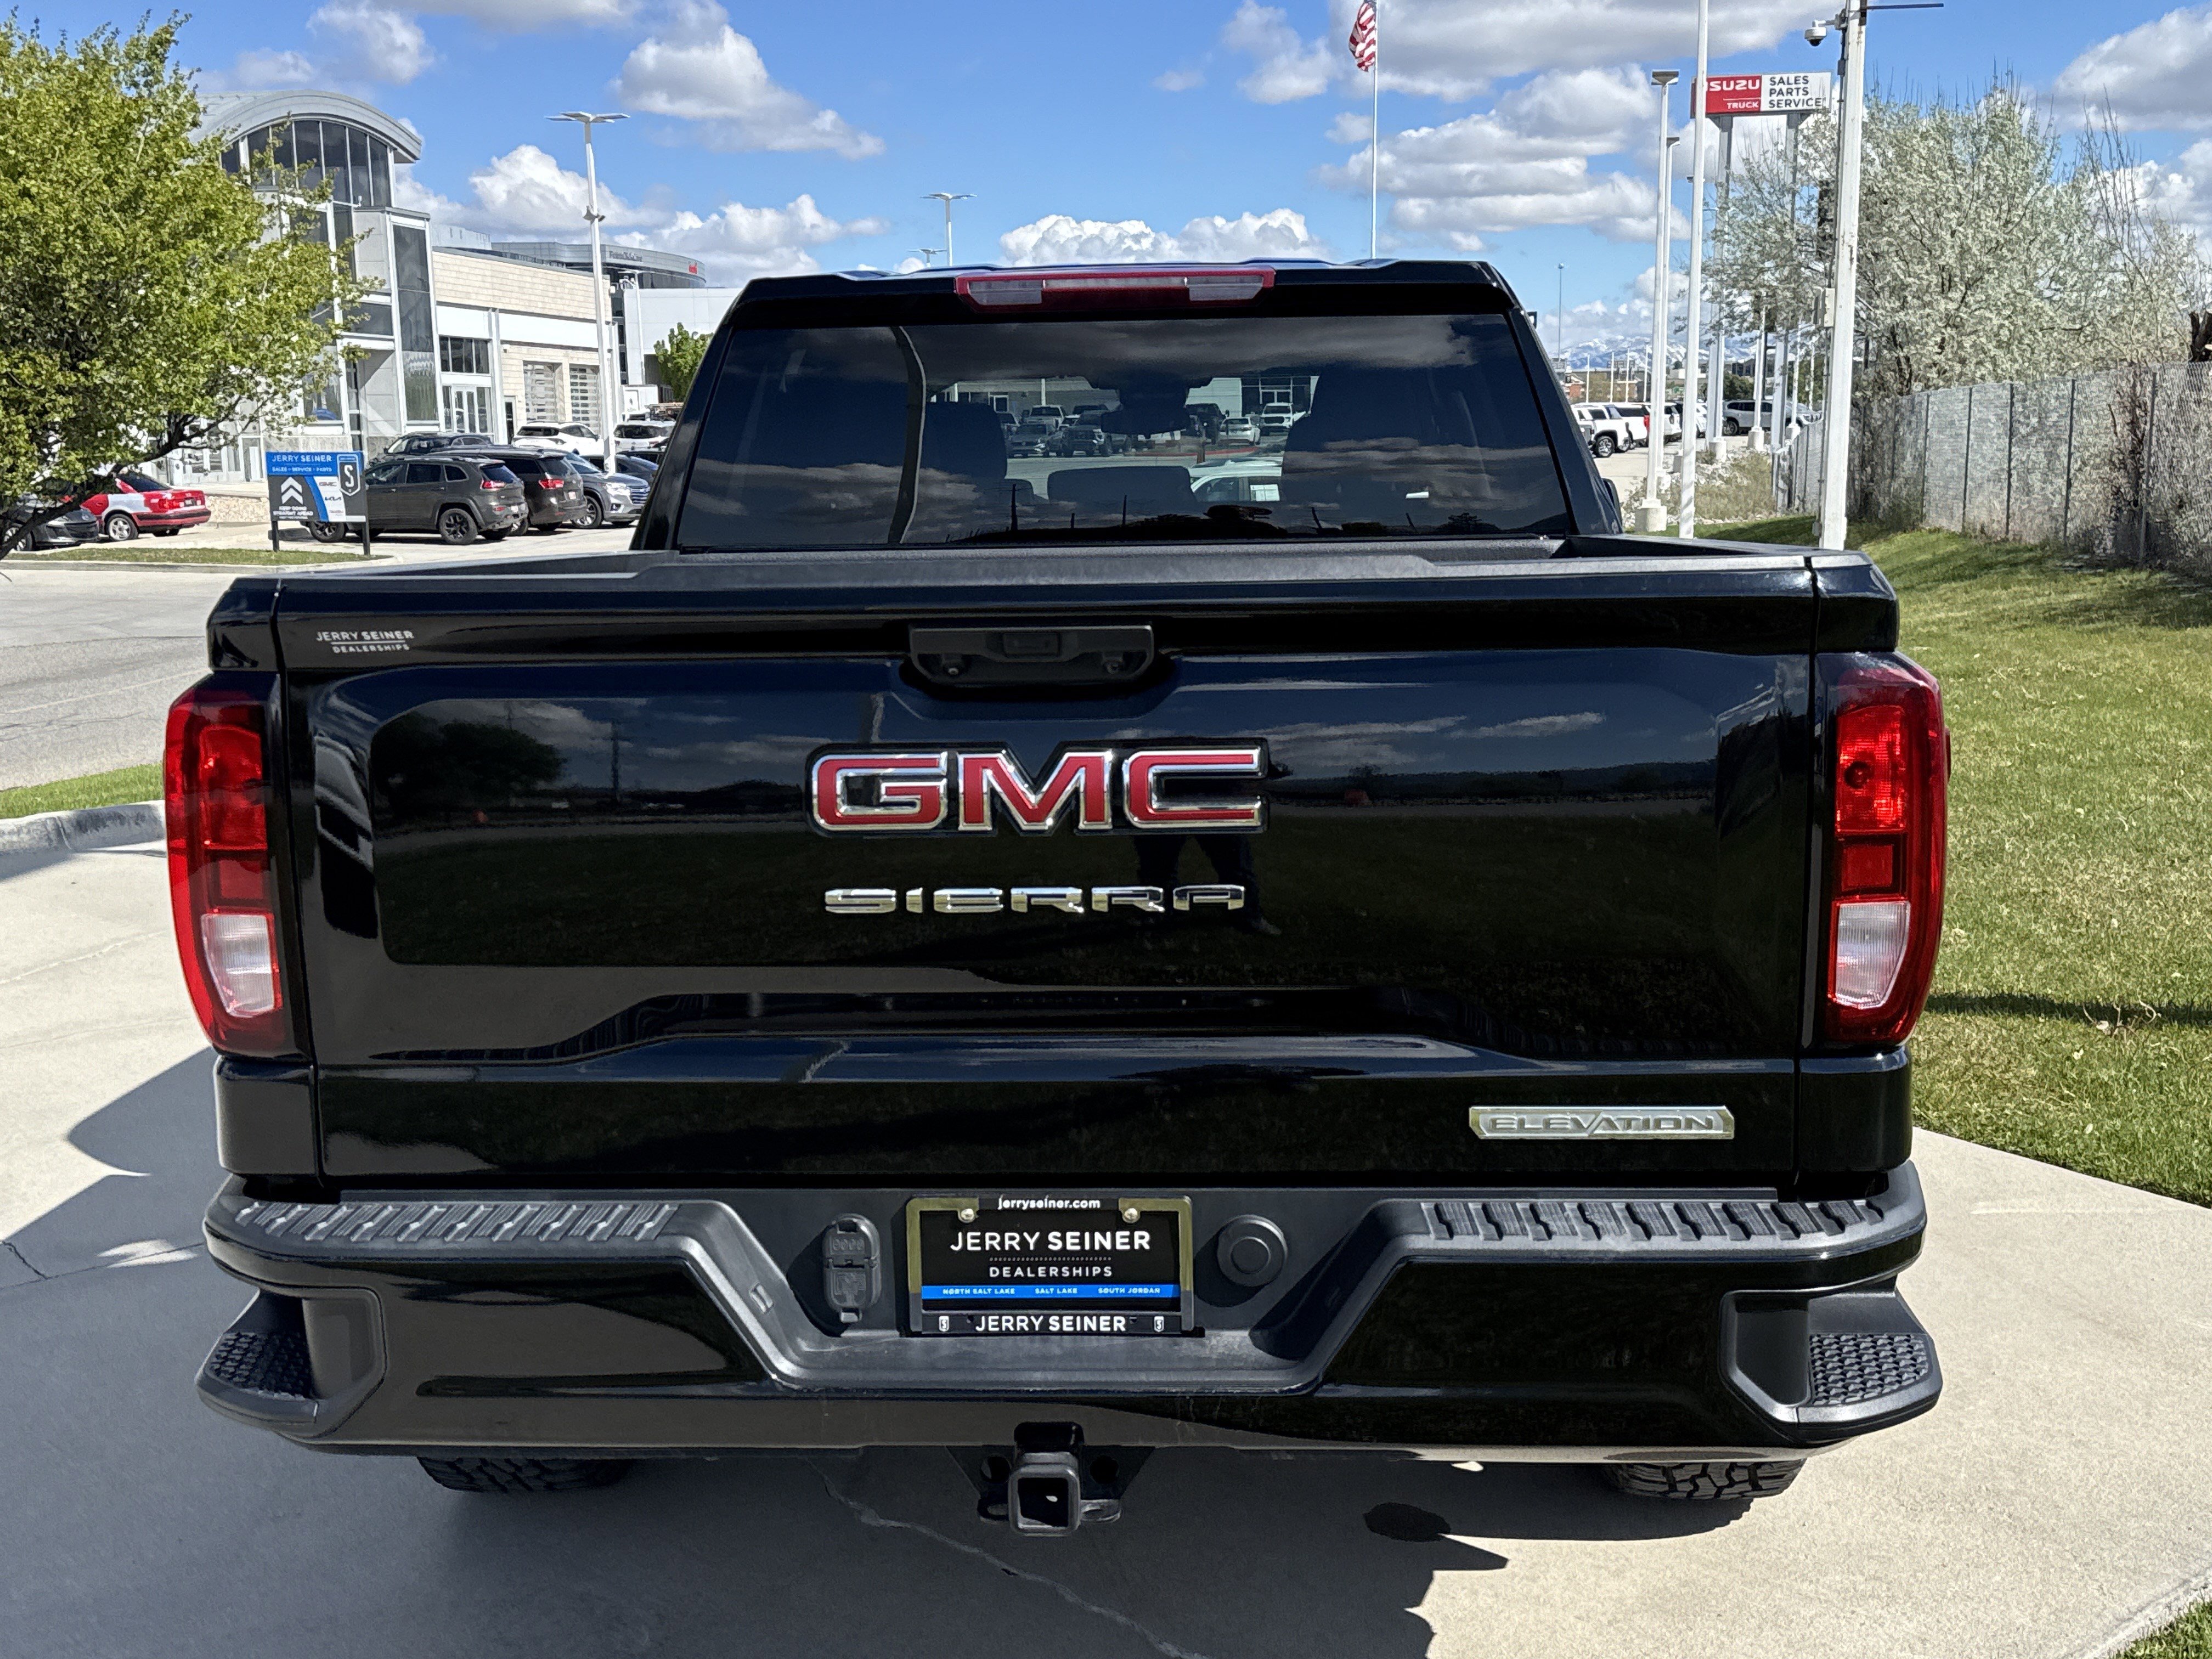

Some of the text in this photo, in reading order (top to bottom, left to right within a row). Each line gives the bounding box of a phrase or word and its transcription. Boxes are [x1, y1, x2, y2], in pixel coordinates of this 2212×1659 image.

[1769, 76, 1809, 86] SALES
[1769, 87, 1809, 97] PARTS
[1727, 101, 1759, 110] TRUCK
[1769, 97, 1822, 109] SERVICE
[344, 465, 354, 487] S
[317, 630, 415, 641] JERRY SEINER
[332, 644, 410, 653] DEALERSHIPS
[812, 749, 1266, 832] GMC
[825, 884, 1245, 913] SIERRA
[1488, 1111, 1714, 1131] ELEVATION
[998, 1195, 1101, 1210] jerryseiner.com
[950, 1231, 1150, 1251] JERRY SEINER
[989, 1266, 1113, 1277] DEALERSHIPS
[975, 1316, 1126, 1331] JERRY SEINER
